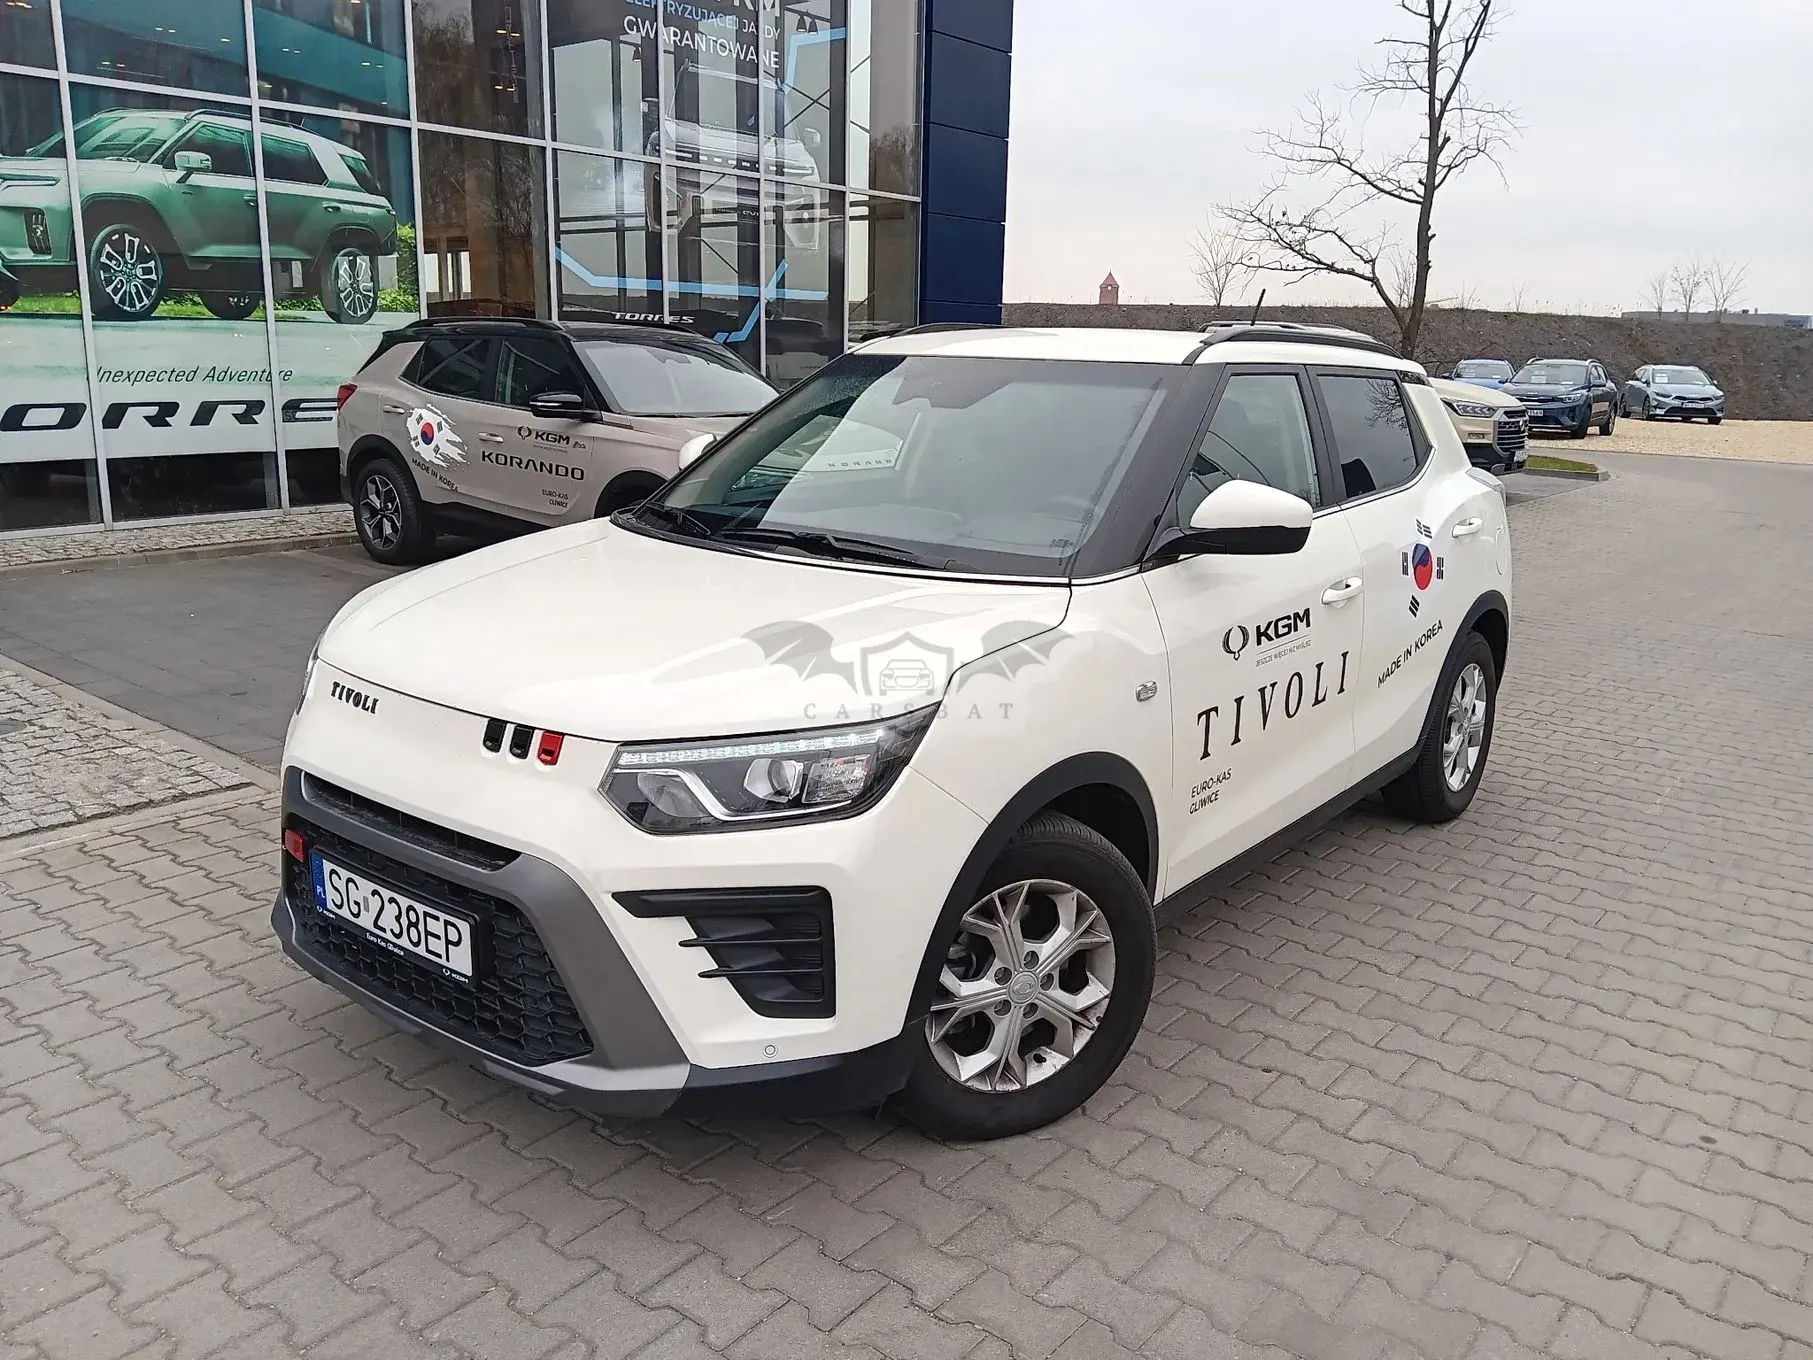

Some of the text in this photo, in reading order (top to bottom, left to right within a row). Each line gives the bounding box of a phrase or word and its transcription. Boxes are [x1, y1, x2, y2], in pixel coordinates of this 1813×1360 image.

[626, 0, 780, 41] ERYZUJĄCEJ JADY
[97, 366, 200, 387] nexpected
[534, 431, 571, 446] KGM
[411, 457, 459, 493] MADE IN KOREA
[481, 450, 586, 481] KORANDO
[1255, 607, 1311, 647] KGM
[1377, 619, 1443, 689] MADE IN KOREA
[330, 681, 380, 715] TIVOLI
[1196, 650, 1350, 761] TIVOLI
[1191, 767, 1232, 799] EURO-KAS
[1189, 789, 1220, 815] GLIWICE
[316, 885, 326, 899] PL
[328, 867, 463, 964] SG 238EP
